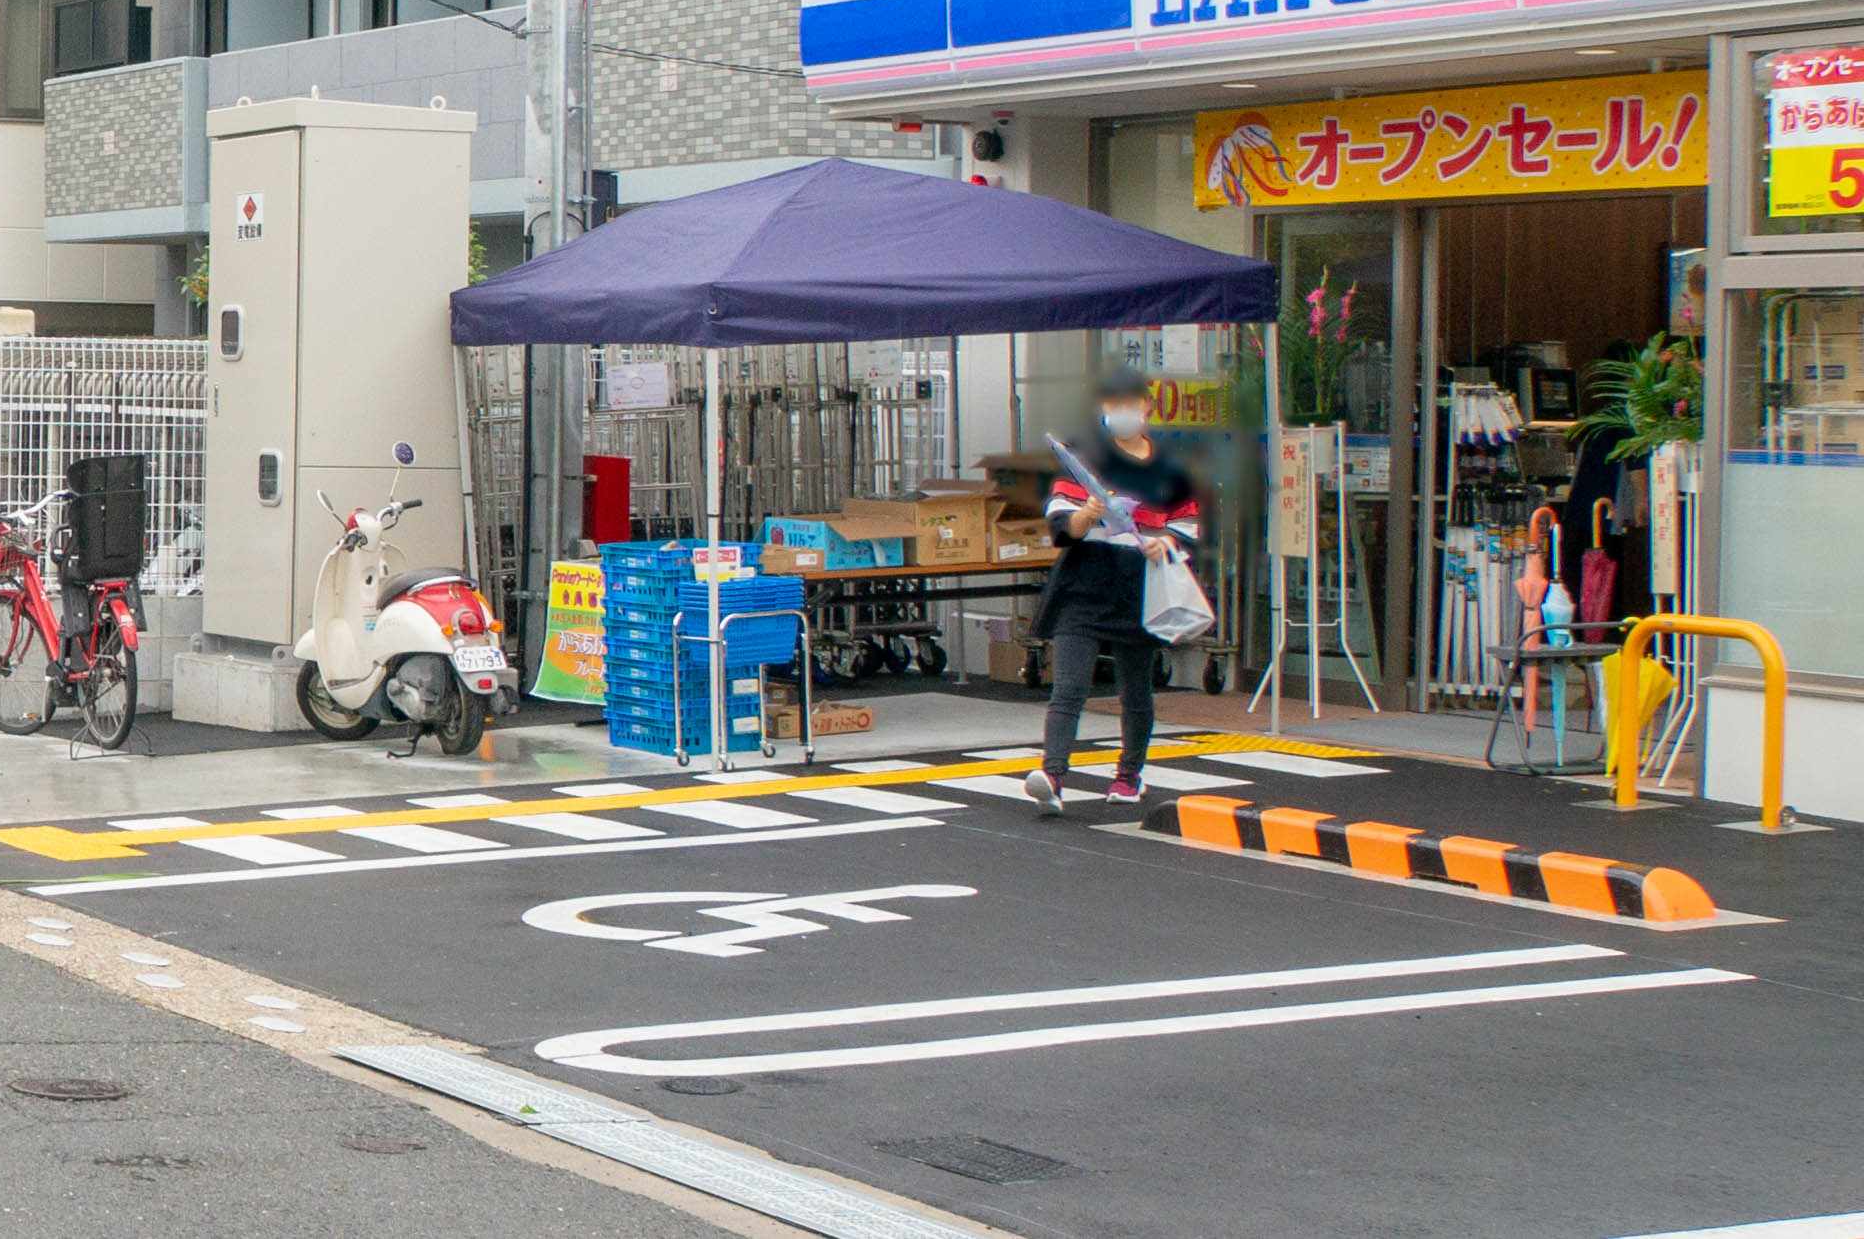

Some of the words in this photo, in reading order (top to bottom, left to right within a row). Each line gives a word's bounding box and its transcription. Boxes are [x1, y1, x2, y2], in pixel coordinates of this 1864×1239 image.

[1296, 94, 1699, 190] オープンセール!
